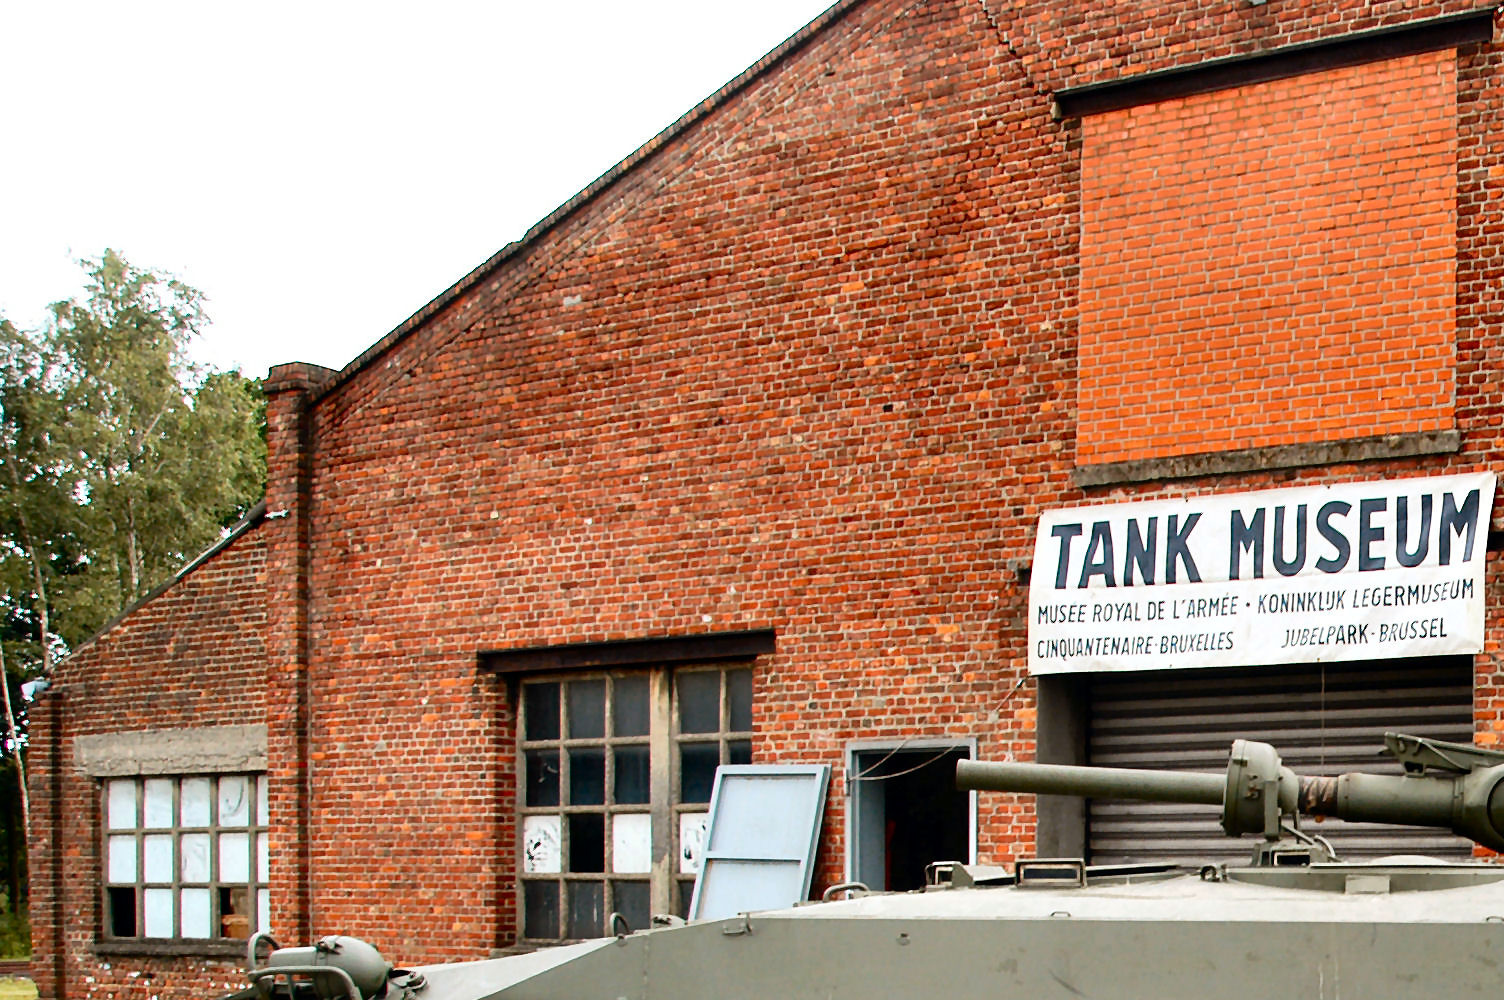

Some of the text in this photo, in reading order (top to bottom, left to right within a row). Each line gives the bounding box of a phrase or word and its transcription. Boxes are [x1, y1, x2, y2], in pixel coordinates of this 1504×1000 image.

[1050, 489, 1482, 590] TANK MUSEUM
[1037, 602, 1088, 625] MUSÉE
[1092, 598, 1141, 622] ROYAL
[1146, 600, 1166, 621] DE
[1257, 589, 1347, 614] KONINKLIJK
[1352, 578, 1474, 609] LEGERMUSEUM
